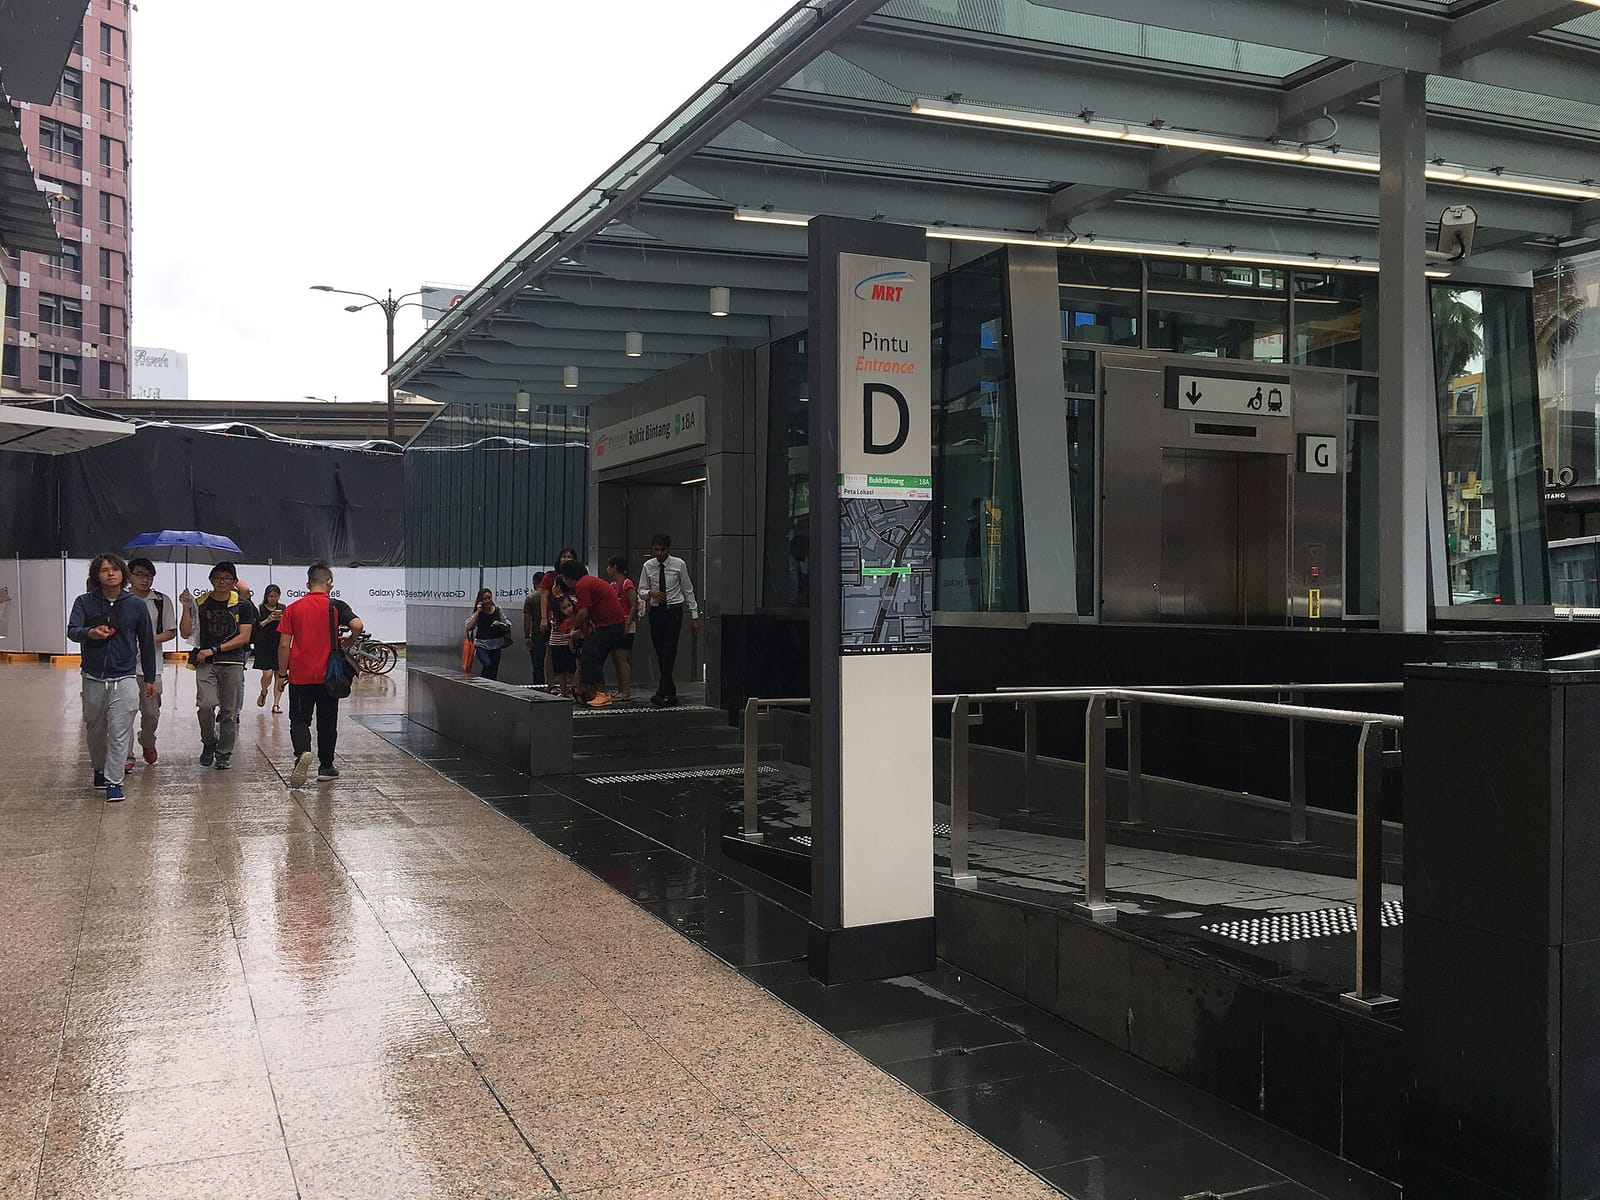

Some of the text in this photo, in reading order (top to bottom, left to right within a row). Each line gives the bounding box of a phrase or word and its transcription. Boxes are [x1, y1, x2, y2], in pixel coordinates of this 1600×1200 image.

[872, 284, 904, 302] MRT
[863, 331, 909, 353] Pintu
[856, 355, 915, 374] Entrance
[863, 382, 910, 454] D
[628, 429, 645, 446] Bukit
[645, 421, 672, 440] Bintang
[680, 411, 696, 431] 18A
[1314, 443, 1329, 468] G
[868, 476, 883, 484] Bukit
[883, 477, 905, 486] Bintang
[919, 478, 930, 486] 18A
[856, 488, 874, 496] Lokasi
[1544, 492, 1566, 500] TANG
[368, 588, 395, 599] Galaxy
